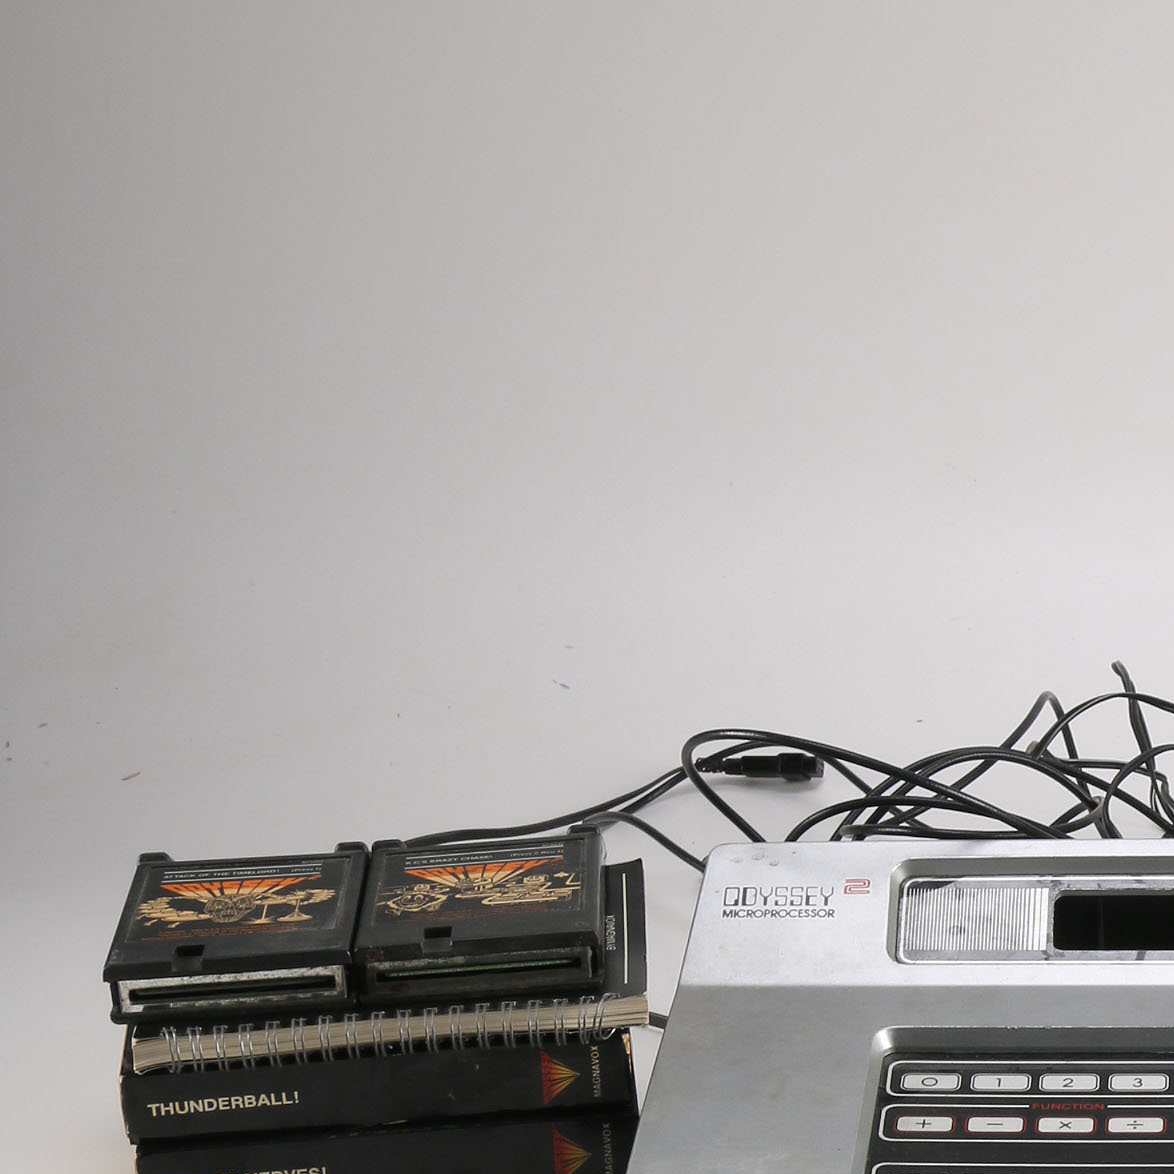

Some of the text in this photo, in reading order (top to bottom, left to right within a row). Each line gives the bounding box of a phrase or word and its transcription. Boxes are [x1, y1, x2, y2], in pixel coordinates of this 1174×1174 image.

[723, 886, 835, 907] ODYSSEY
[722, 908, 836, 919] MICROPROCESSOR
[591, 1045, 600, 1098] MAGNAVOX
[921, 1077, 939, 1087] 0
[996, 1077, 1002, 1088] 1
[1062, 1077, 1074, 1088] 2
[1132, 1077, 1143, 1088] 3
[147, 1091, 300, 1117] THUNDERBALL!
[1032, 1103, 1105, 1111] FUNCTION
